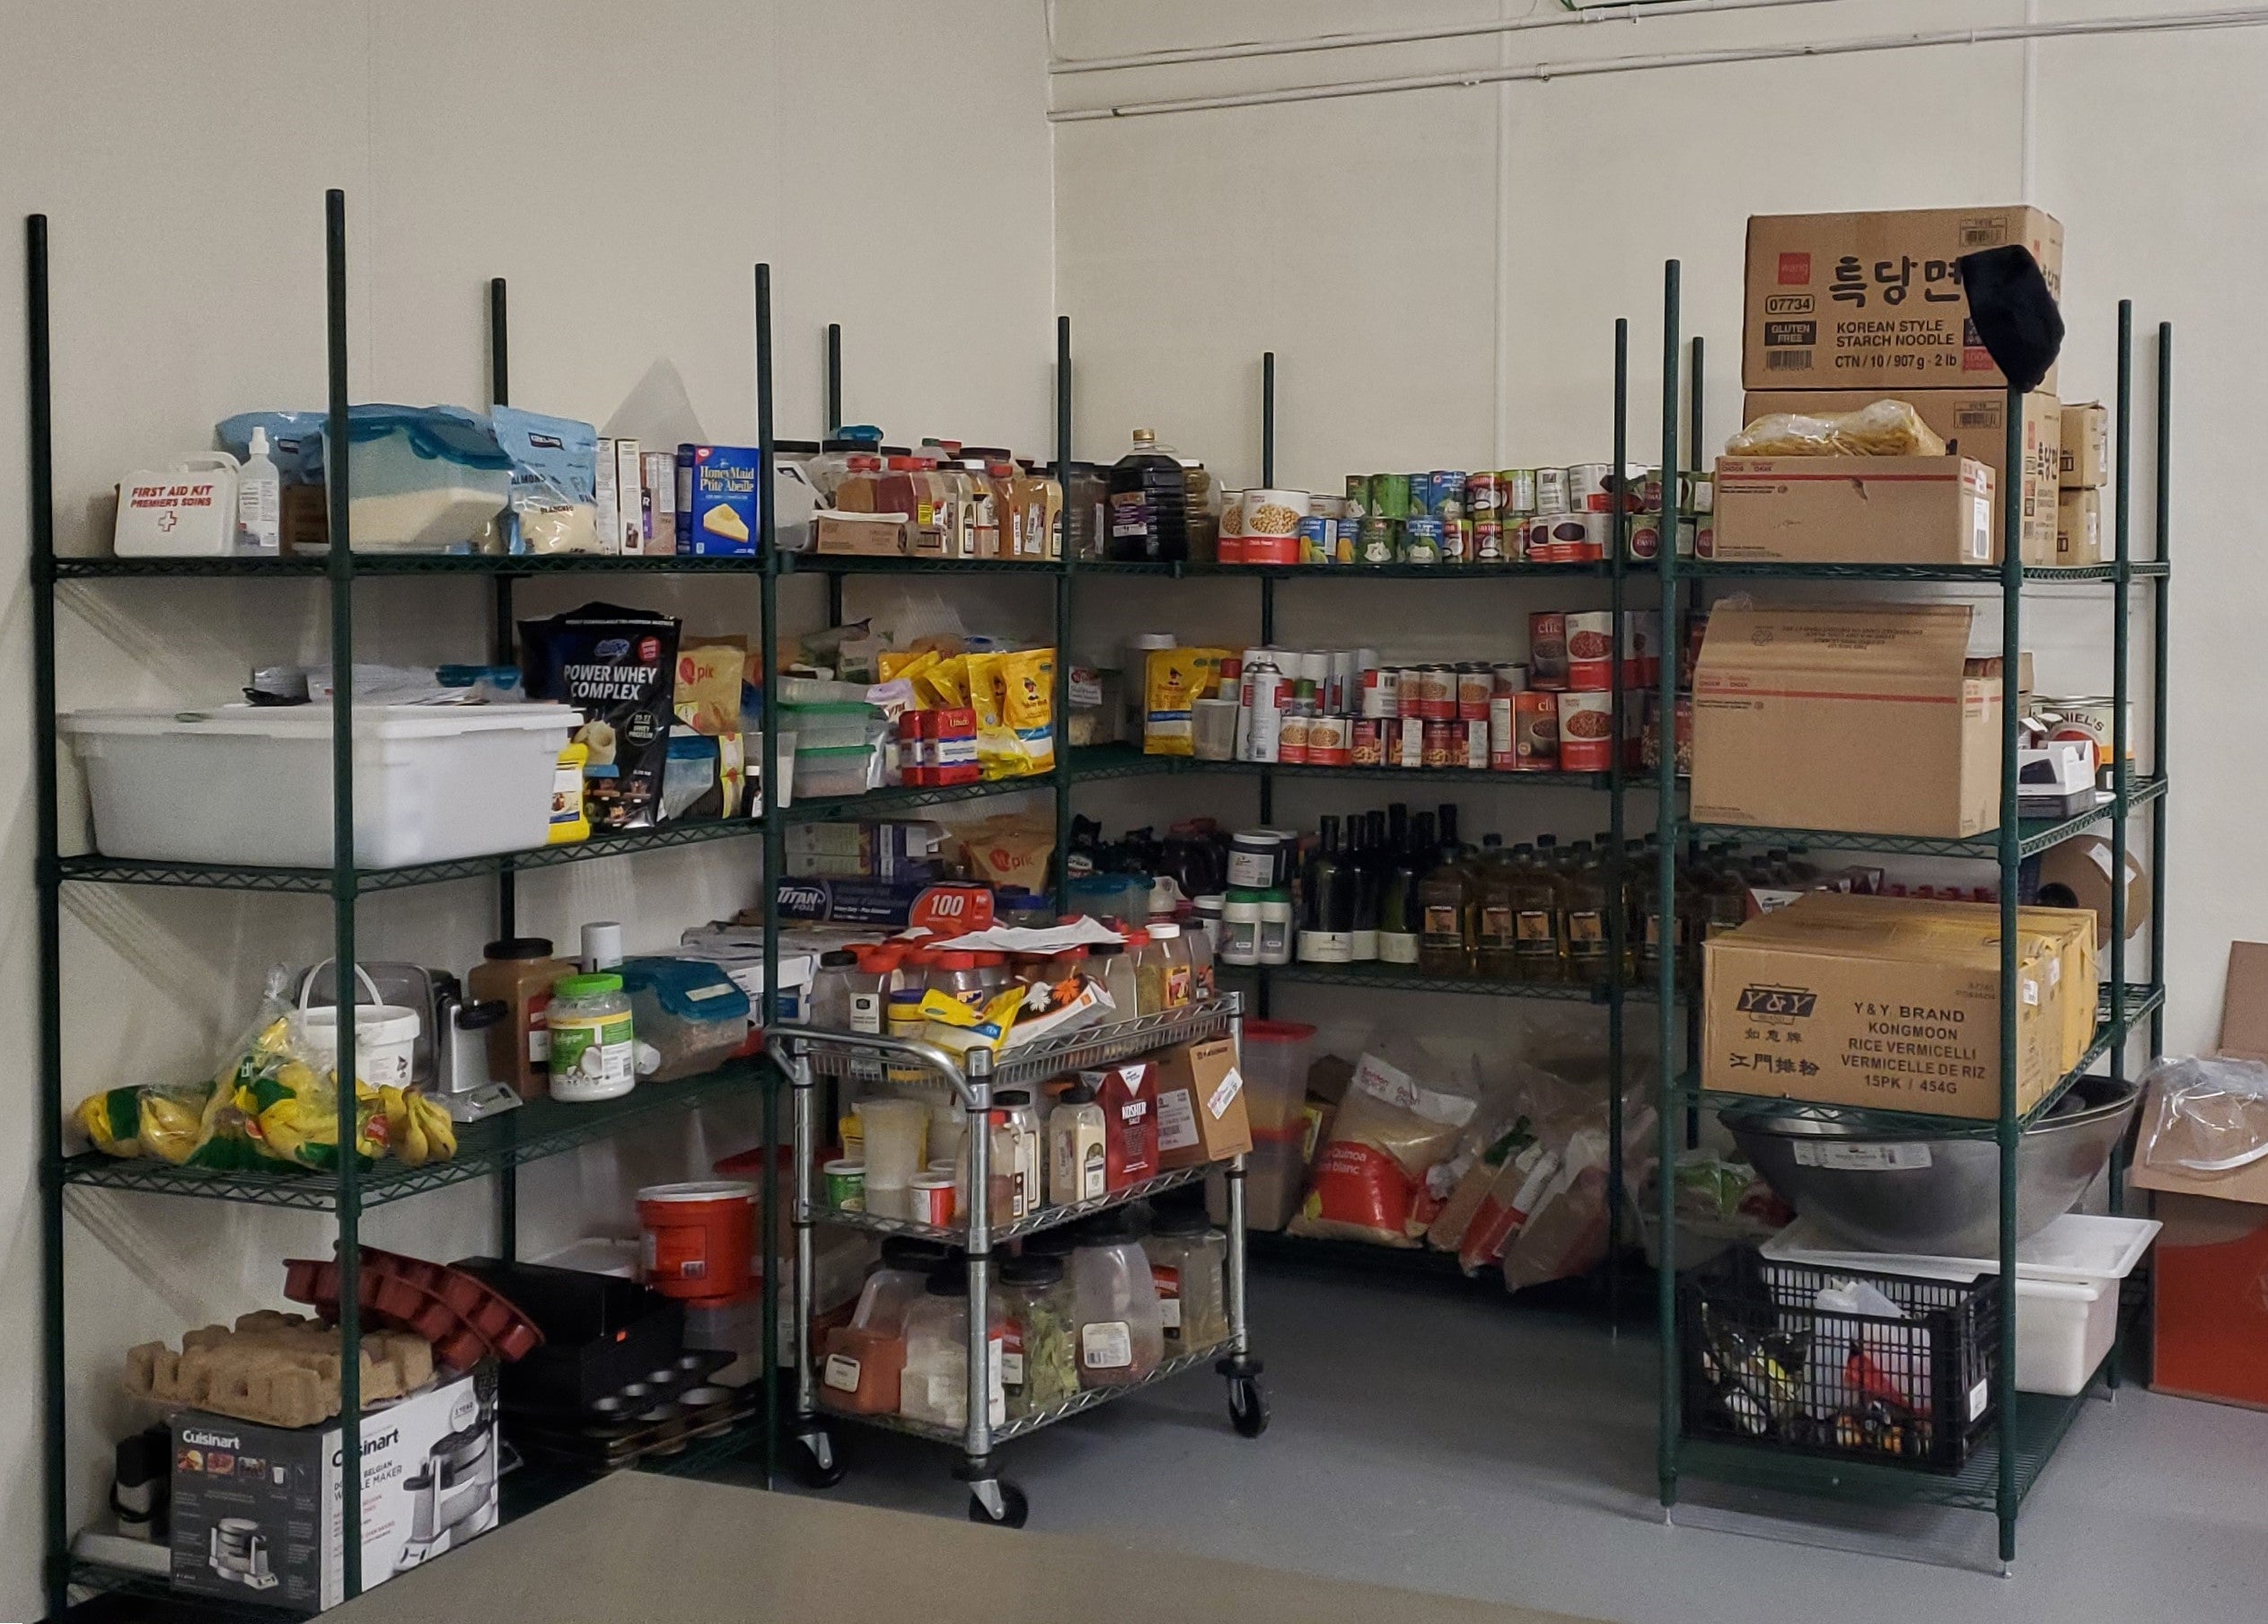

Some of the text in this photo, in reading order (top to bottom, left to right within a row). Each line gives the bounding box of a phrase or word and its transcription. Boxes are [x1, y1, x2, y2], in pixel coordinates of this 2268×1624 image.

[1770, 299, 1810, 311] 07734
[1771, 324, 1810, 333] GLUTEN
[1837, 320, 1944, 334] KOREAN STYLE
[1778, 334, 1803, 343] FREE
[1836, 333, 1955, 347] STARCH NOODLE
[1835, 355, 1859, 368] CTN
[1871, 355, 1884, 367] 10
[1946, 354, 1957, 366] lb
[132, 485, 215, 497] FIRST AID KIT
[130, 497, 212, 507] PREMIERS SOINS
[564, 664, 657, 684] POWER WHEY
[571, 681, 642, 700] COMPLEX
[2061, 712, 2105, 732] NIEL'S
[930, 894, 964, 917] 100
[1899, 1005, 1965, 1023] BRAND
[1868, 1022, 1958, 1040] KONGMOON
[1849, 1037, 1977, 1061] RICE VERMICELLI
[1841, 1054, 1986, 1079] VERMICELLE DE RIZ
[1864, 1075, 1901, 1089] 15PK
[1919, 1079, 1958, 1094] 454G
[1121, 1102, 1147, 1120] KOSHER
[182, 1429, 242, 1451] Cuisinart
[332, 1427, 400, 1468] Csinart
[364, 1460, 393, 1479] BELGIAN
[374, 1464, 403, 1486] MAKER
